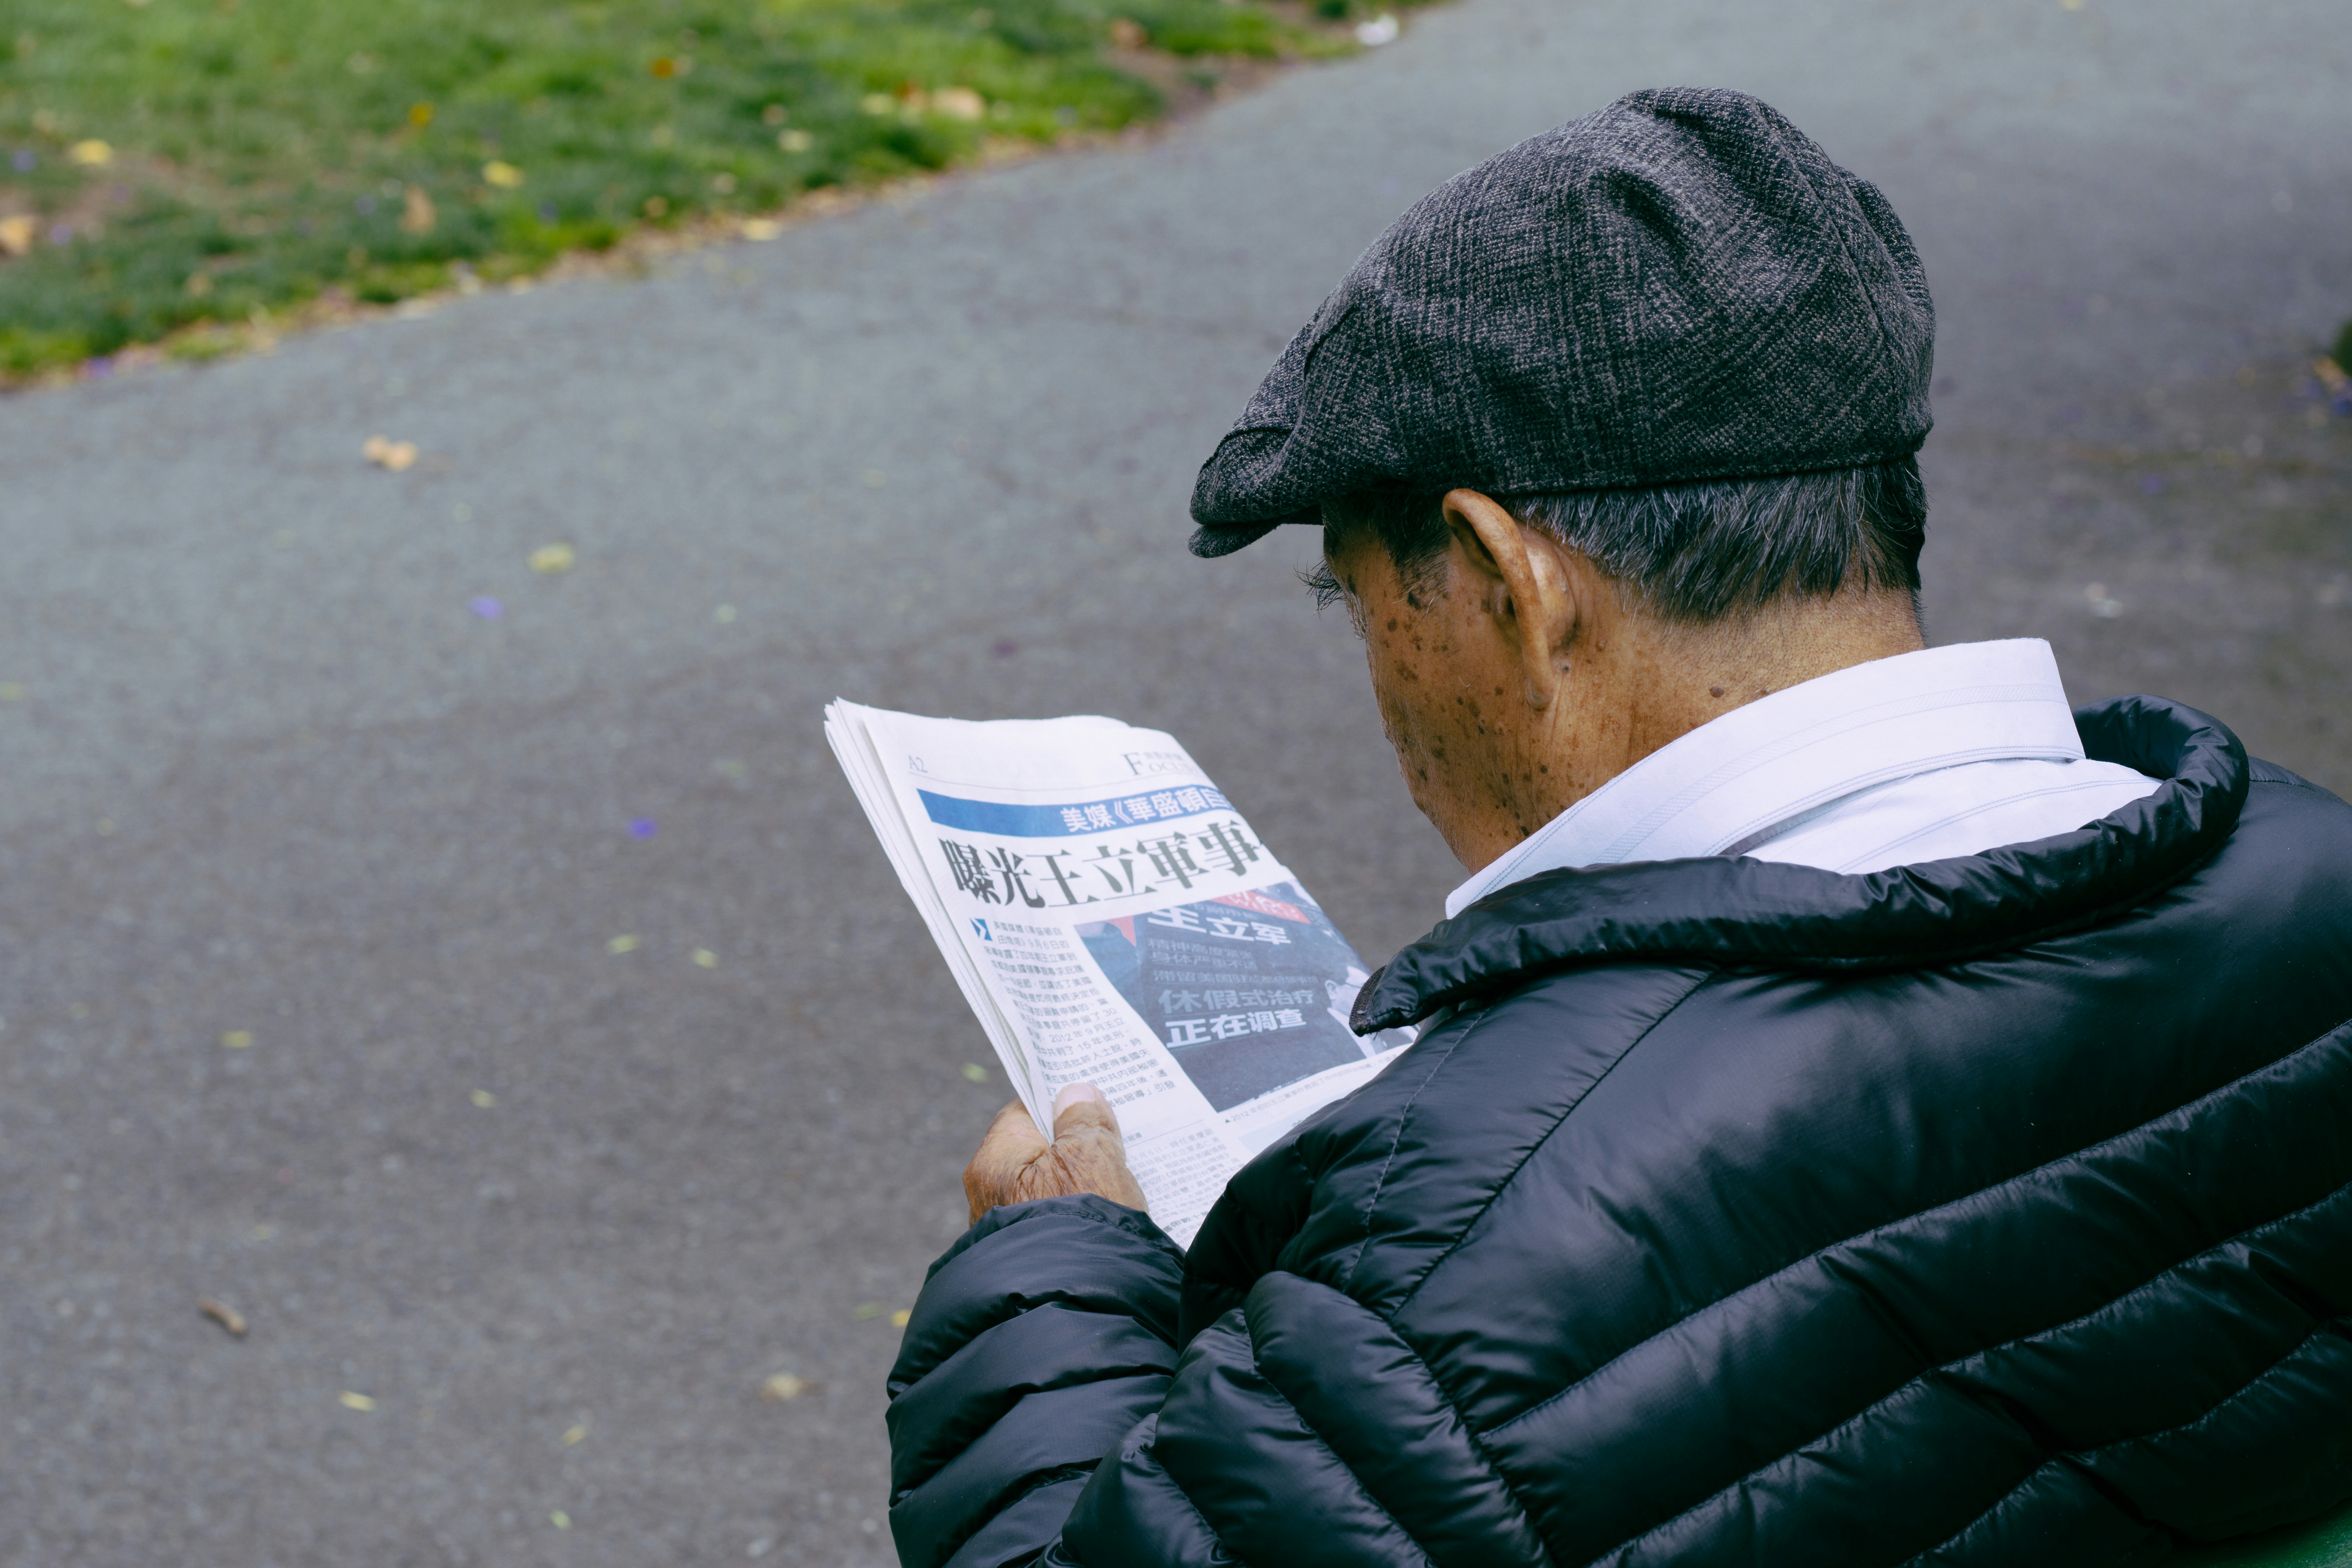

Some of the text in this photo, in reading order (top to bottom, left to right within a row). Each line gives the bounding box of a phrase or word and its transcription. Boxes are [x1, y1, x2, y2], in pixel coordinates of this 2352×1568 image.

[907, 755, 927, 773] A2
[1158, 989, 1314, 1014] 休假式治疗
[1165, 1009, 1307, 1048] 正在调查
